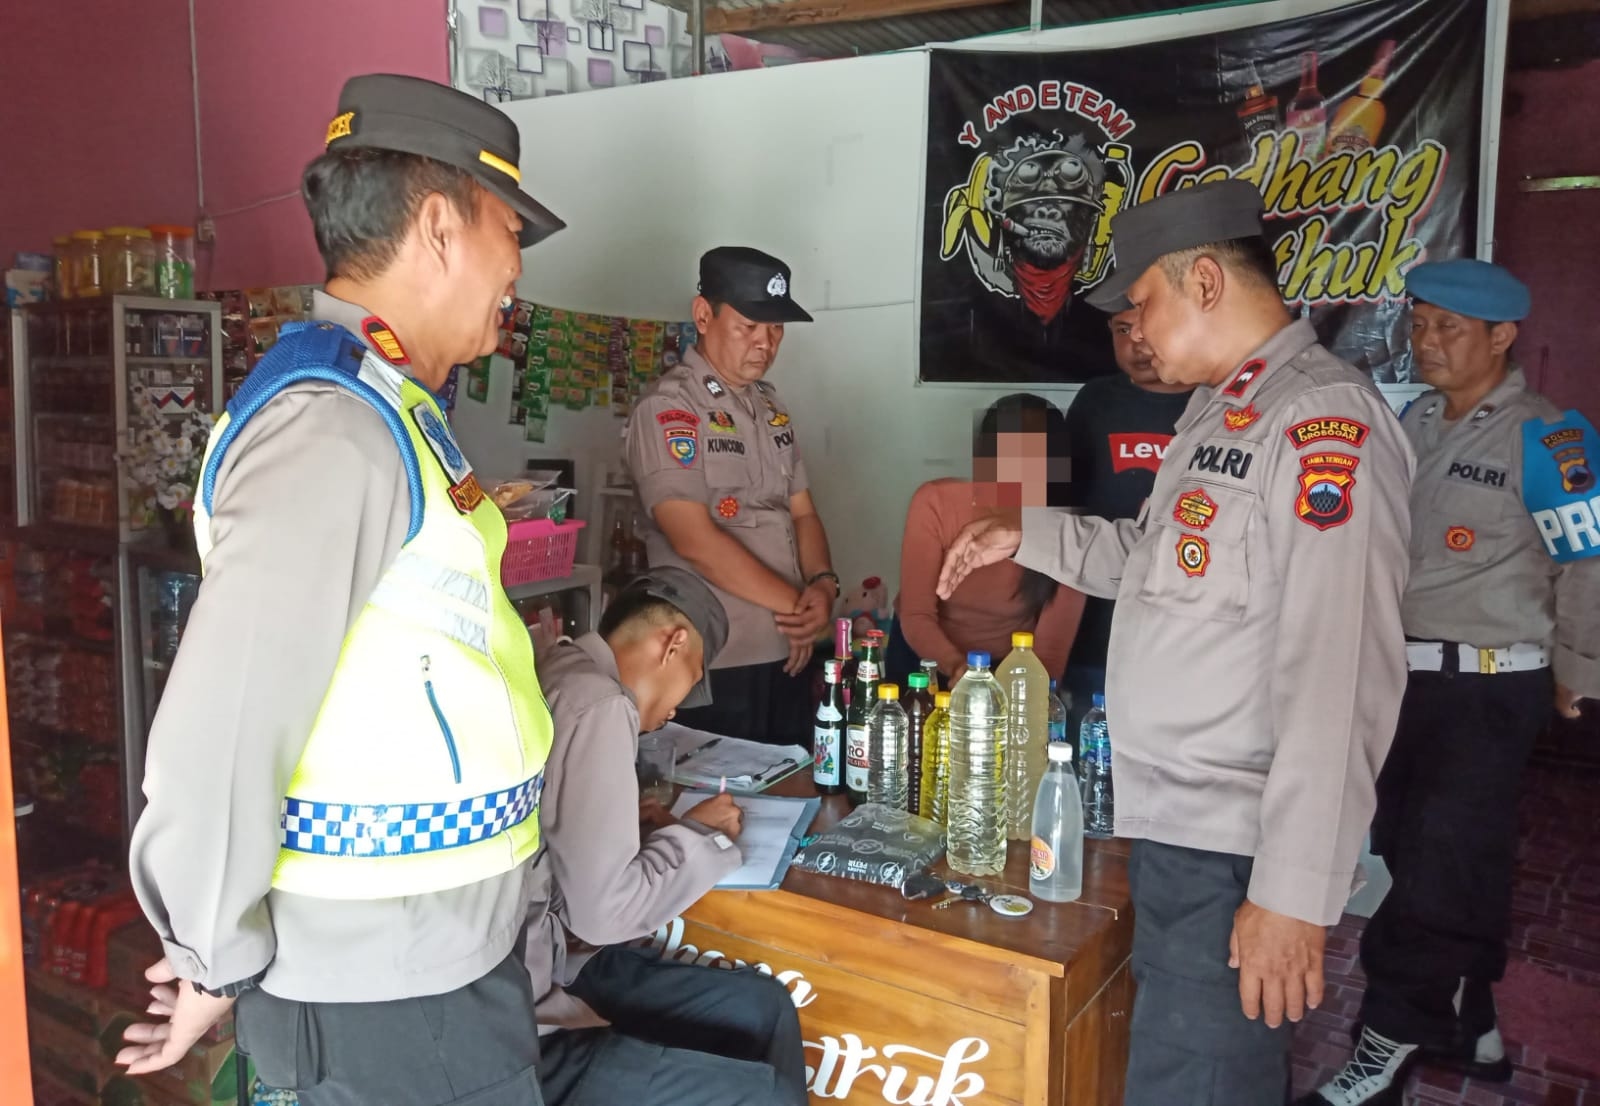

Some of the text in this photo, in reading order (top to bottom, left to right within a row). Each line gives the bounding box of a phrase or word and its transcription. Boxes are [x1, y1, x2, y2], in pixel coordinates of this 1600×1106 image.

[958, 80, 1136, 148] Y AND E TEAM
[1297, 420, 1359, 437] POLRES
[1188, 444, 1253, 480] POLRI
[1448, 462, 1506, 487] POLRI
